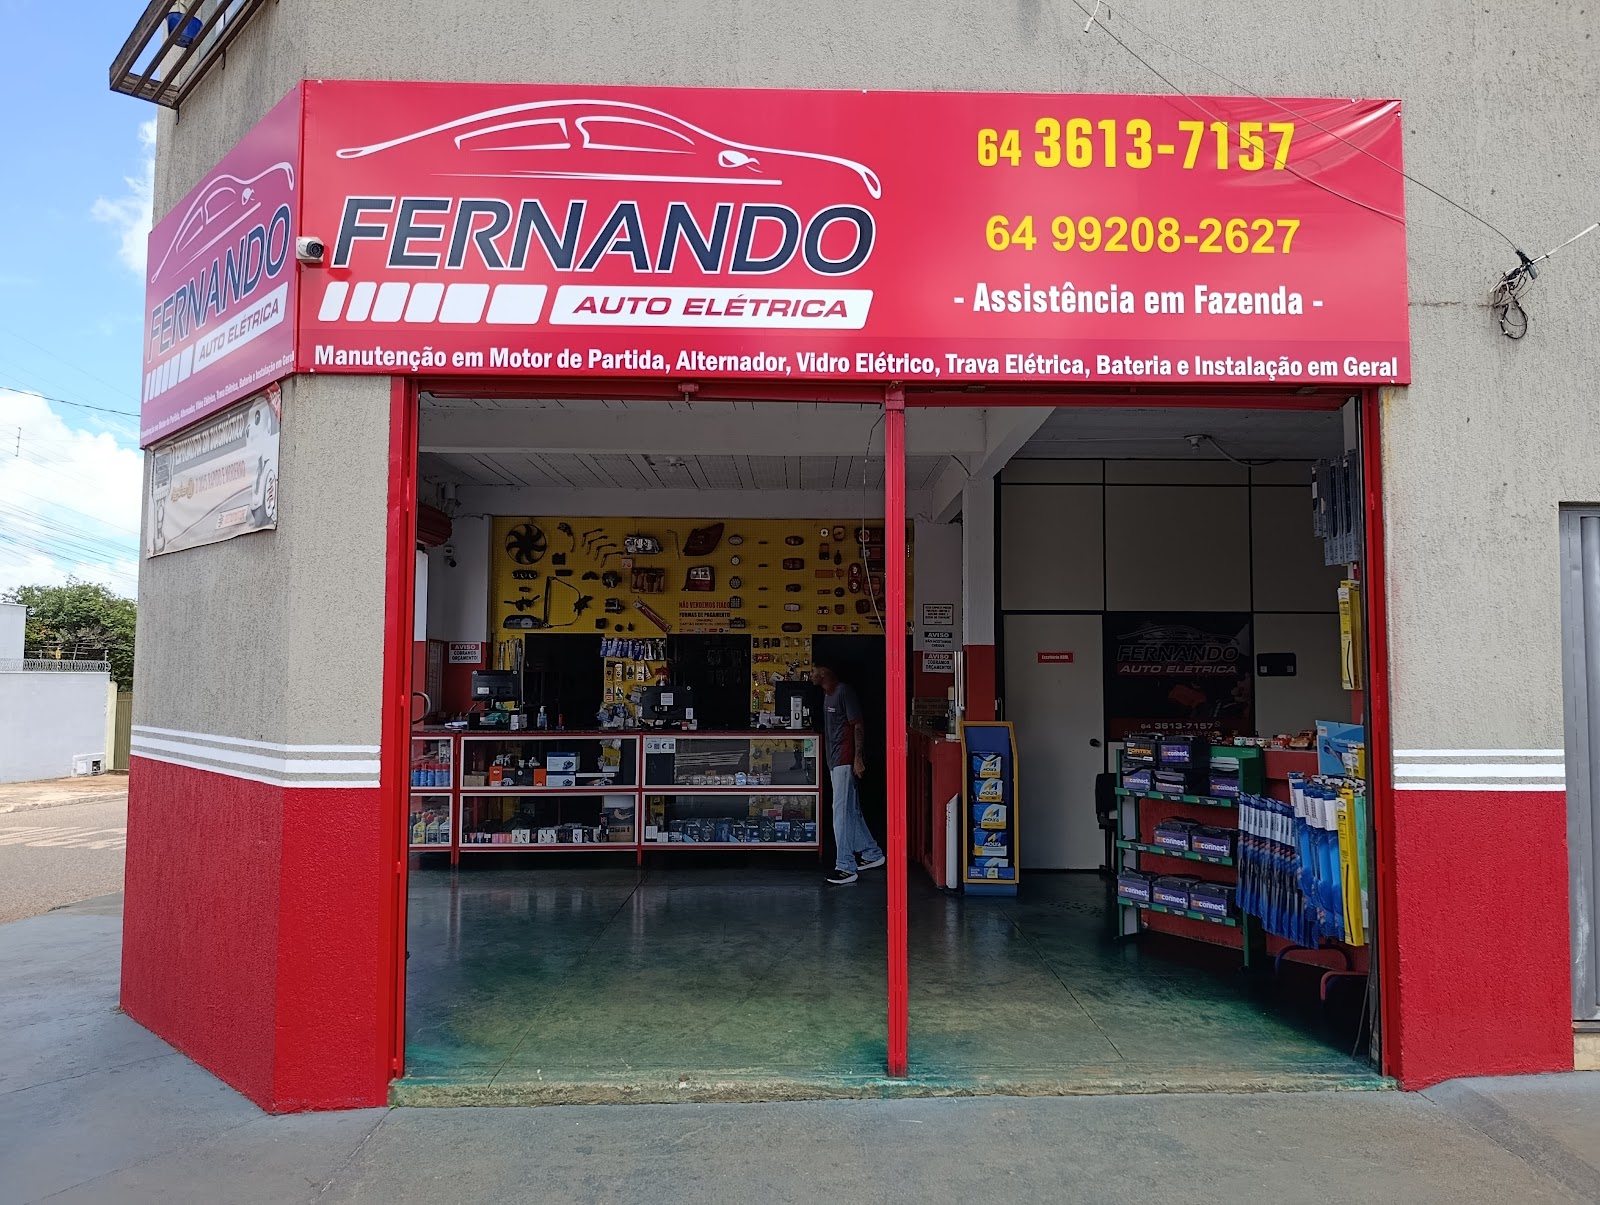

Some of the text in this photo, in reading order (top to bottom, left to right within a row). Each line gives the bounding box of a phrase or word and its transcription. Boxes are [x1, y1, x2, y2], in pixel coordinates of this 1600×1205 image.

[977, 117, 1295, 171] 64 3613-7157
[330, 195, 876, 277] FERNANDO
[985, 215, 1300, 254] 64 99208-2627
[147, 203, 291, 363] FERNANDO
[973, 281, 1135, 314] Assistência
[1144, 289, 1185, 314] em
[1194, 284, 1303, 316] Fazenda
[572, 294, 847, 318] AUTO ELÉTRICA
[199, 298, 279, 362] AUTO ELÉTRICA
[255, 362, 275, 381] Instalação
[282, 350, 295, 366] Geral
[314, 345, 1398, 382] Manutenção em Motor de Partida, Alternador, Vidro Elétrico, Trava Elétrica, Bateria e Instalação em Geral
[1117, 644, 1240, 663] FERNANDO
[1119, 665, 1163, 674] AUTO
[1154, 722, 1214, 731] 3613-7157
